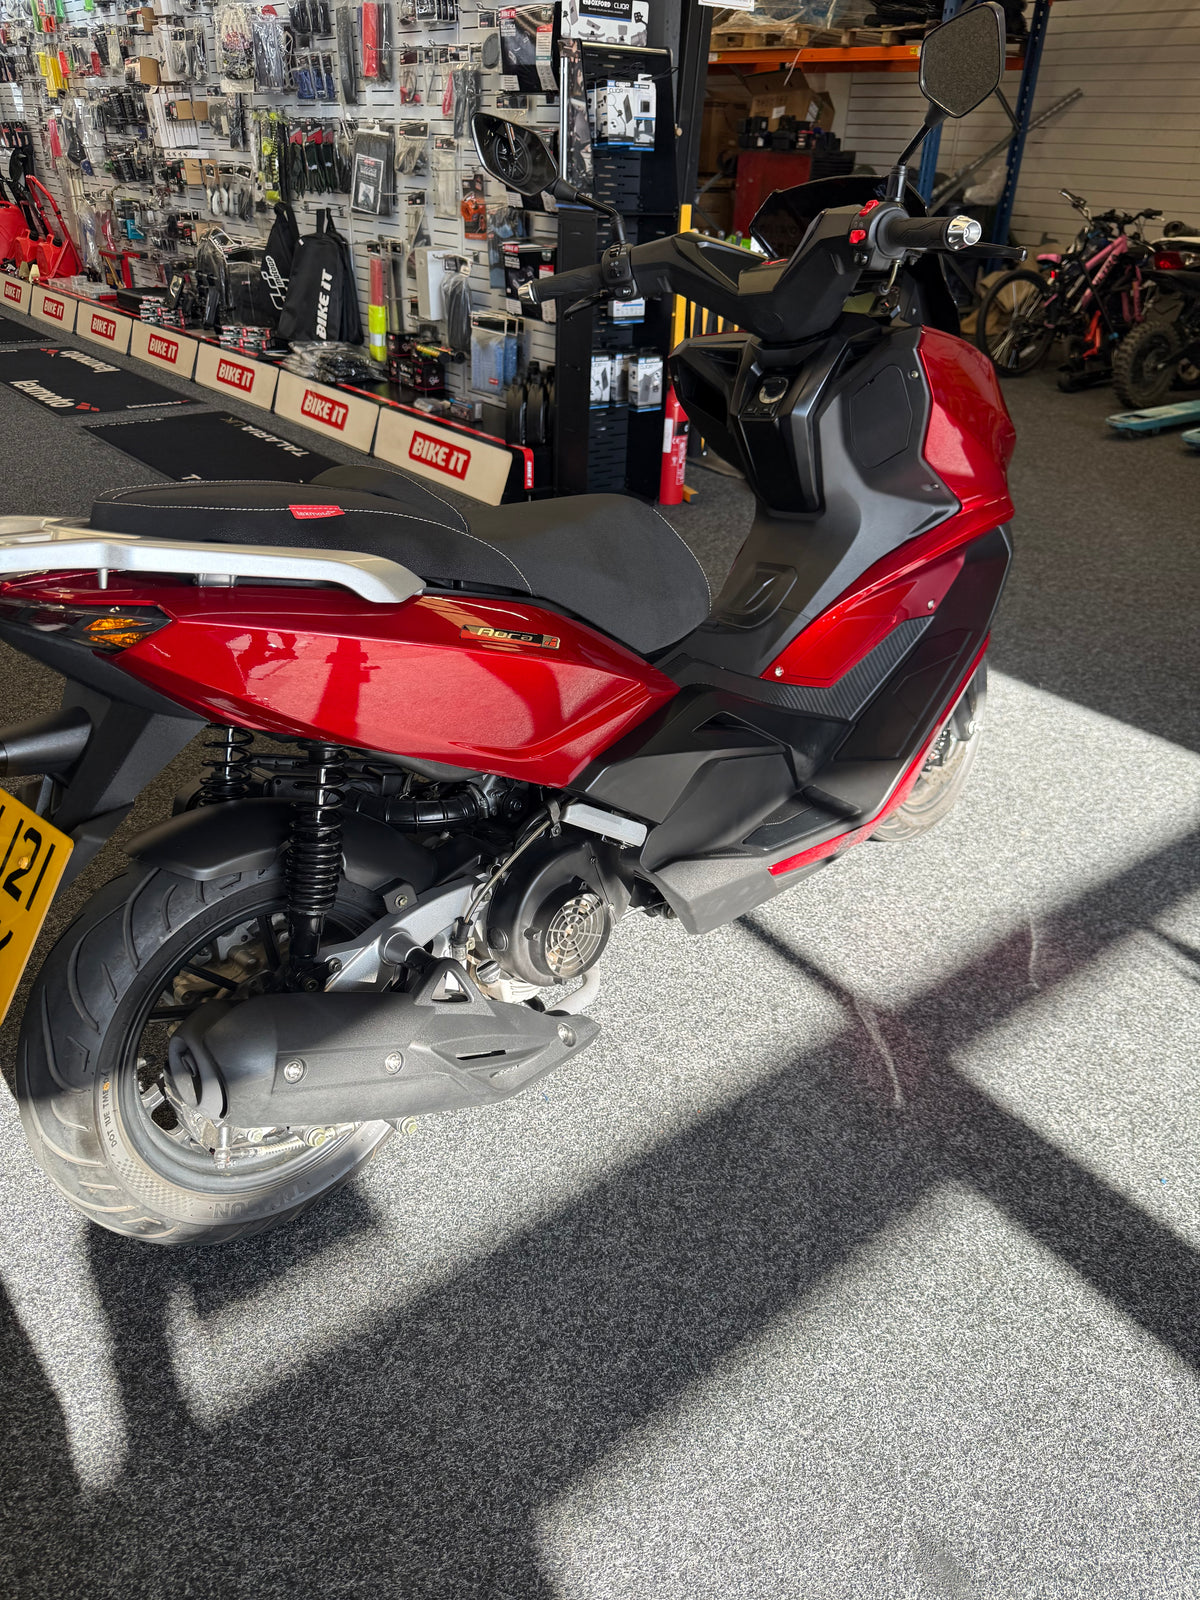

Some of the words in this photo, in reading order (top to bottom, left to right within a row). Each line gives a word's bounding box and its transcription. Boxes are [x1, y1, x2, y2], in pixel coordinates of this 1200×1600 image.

[5, 283, 15, 297] BIKE
[15, 290, 21, 301] IT
[321, 268, 334, 292] IT
[44, 299, 57, 316] BIKE
[57, 306, 64, 319] IT
[316, 292, 331, 340] BIKE
[92, 317, 106, 336] BIKE
[107, 323, 116, 338] IT
[149, 337, 168, 358] BIKE
[168, 343, 178, 361] IT
[59, 350, 121, 373] lexmoto
[218, 363, 241, 384] BIKE
[241, 370, 254, 388] IT
[10, 379, 75, 408] lexmoto
[303, 393, 330, 420] BIKE
[331, 405, 346, 426] IT
[242, 425, 310, 457] TALARIA
[416, 435, 450, 467] BIKE
[448, 450, 468, 474] IT
